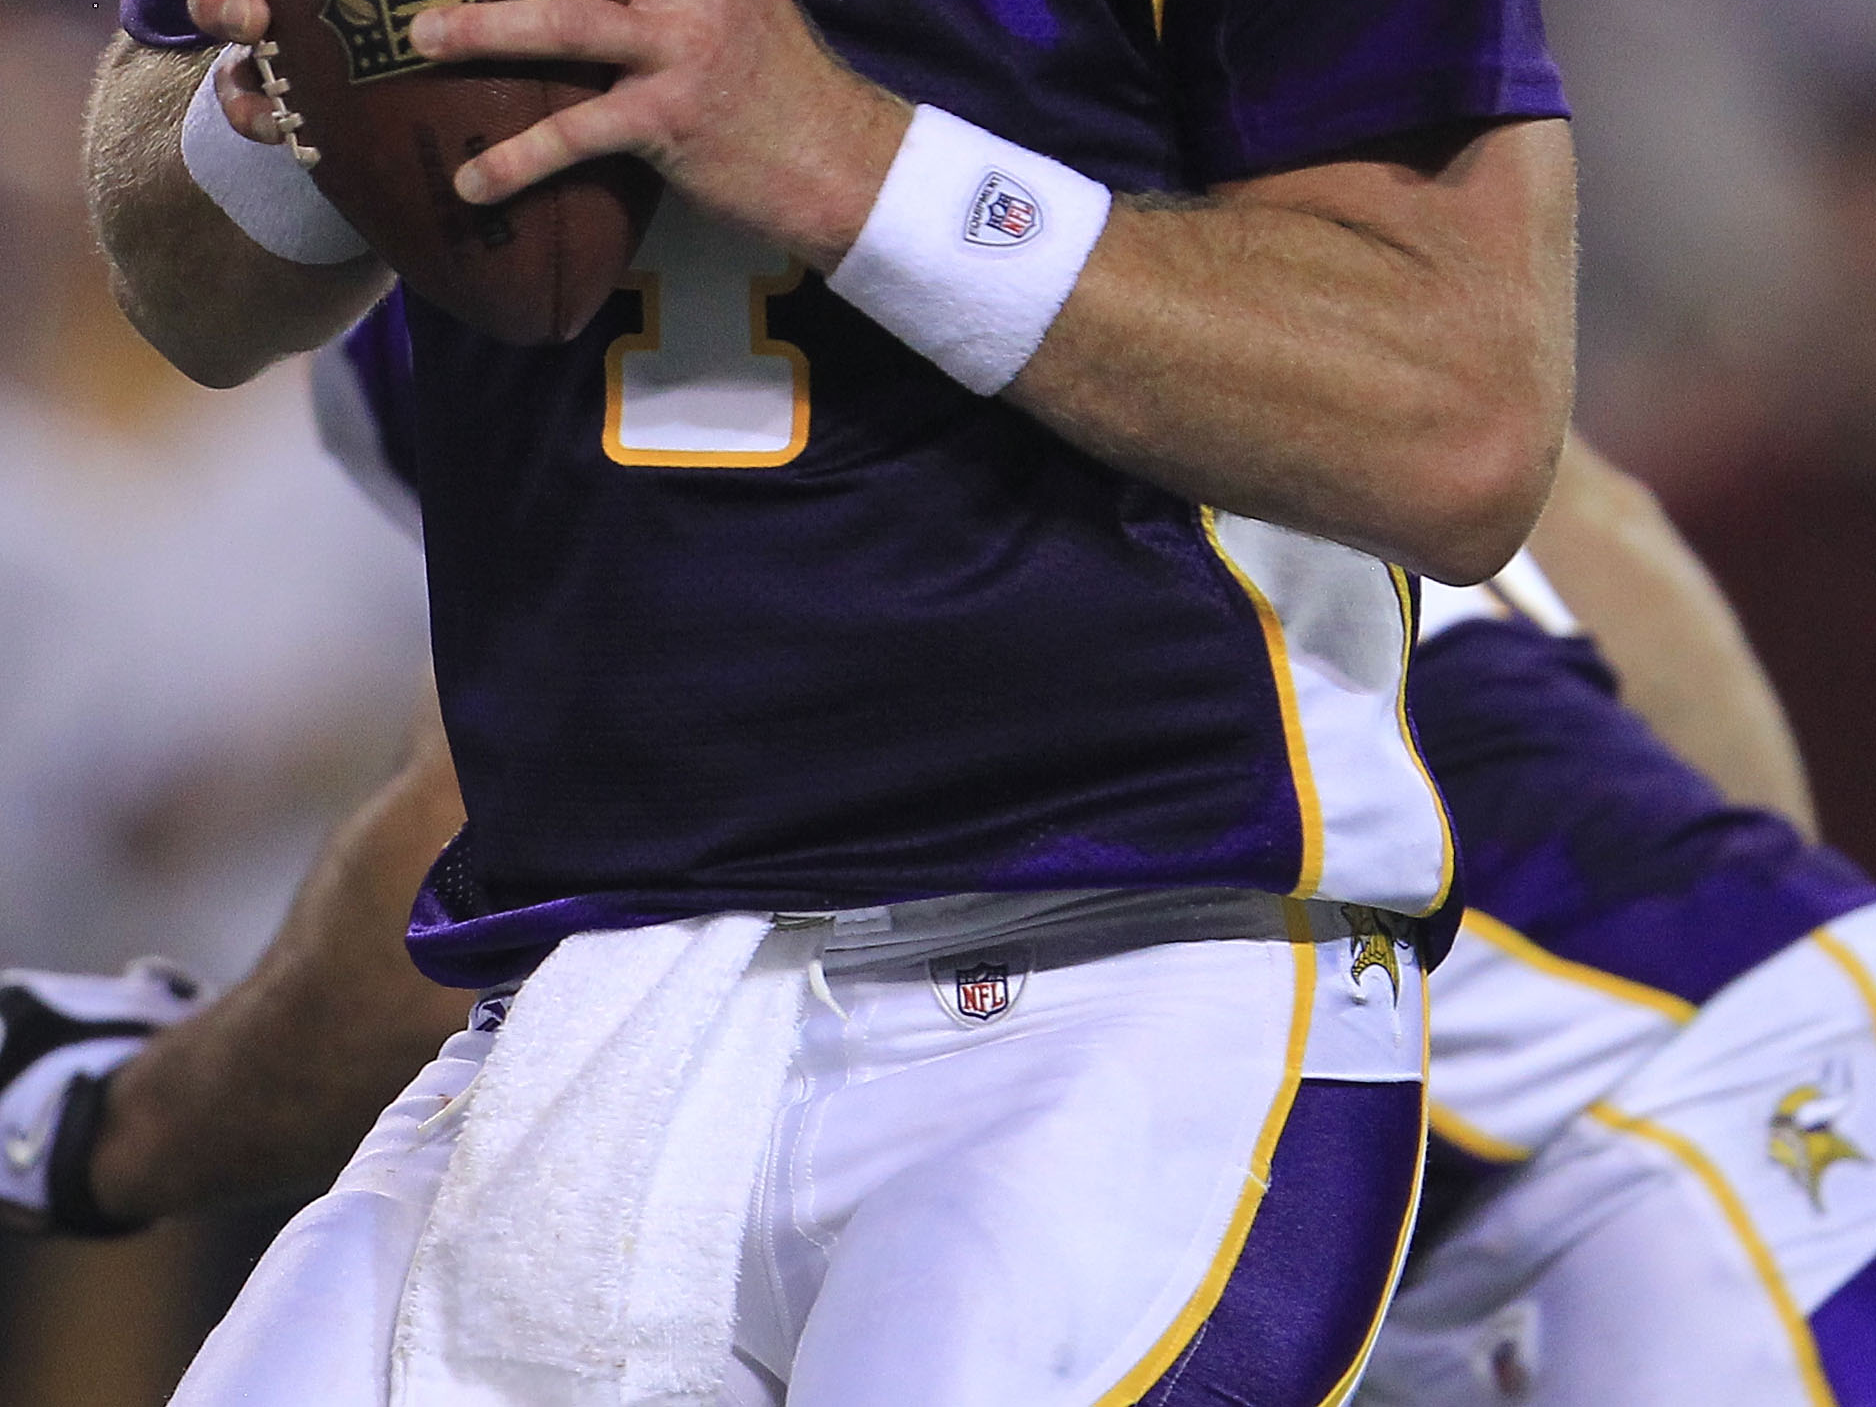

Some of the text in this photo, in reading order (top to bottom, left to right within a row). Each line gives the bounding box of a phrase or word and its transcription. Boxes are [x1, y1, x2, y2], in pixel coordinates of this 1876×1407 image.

[968, 176, 1003, 237] EQUIPMENT
[1001, 204, 1034, 234] NFL
[961, 982, 1005, 1013] NFL
